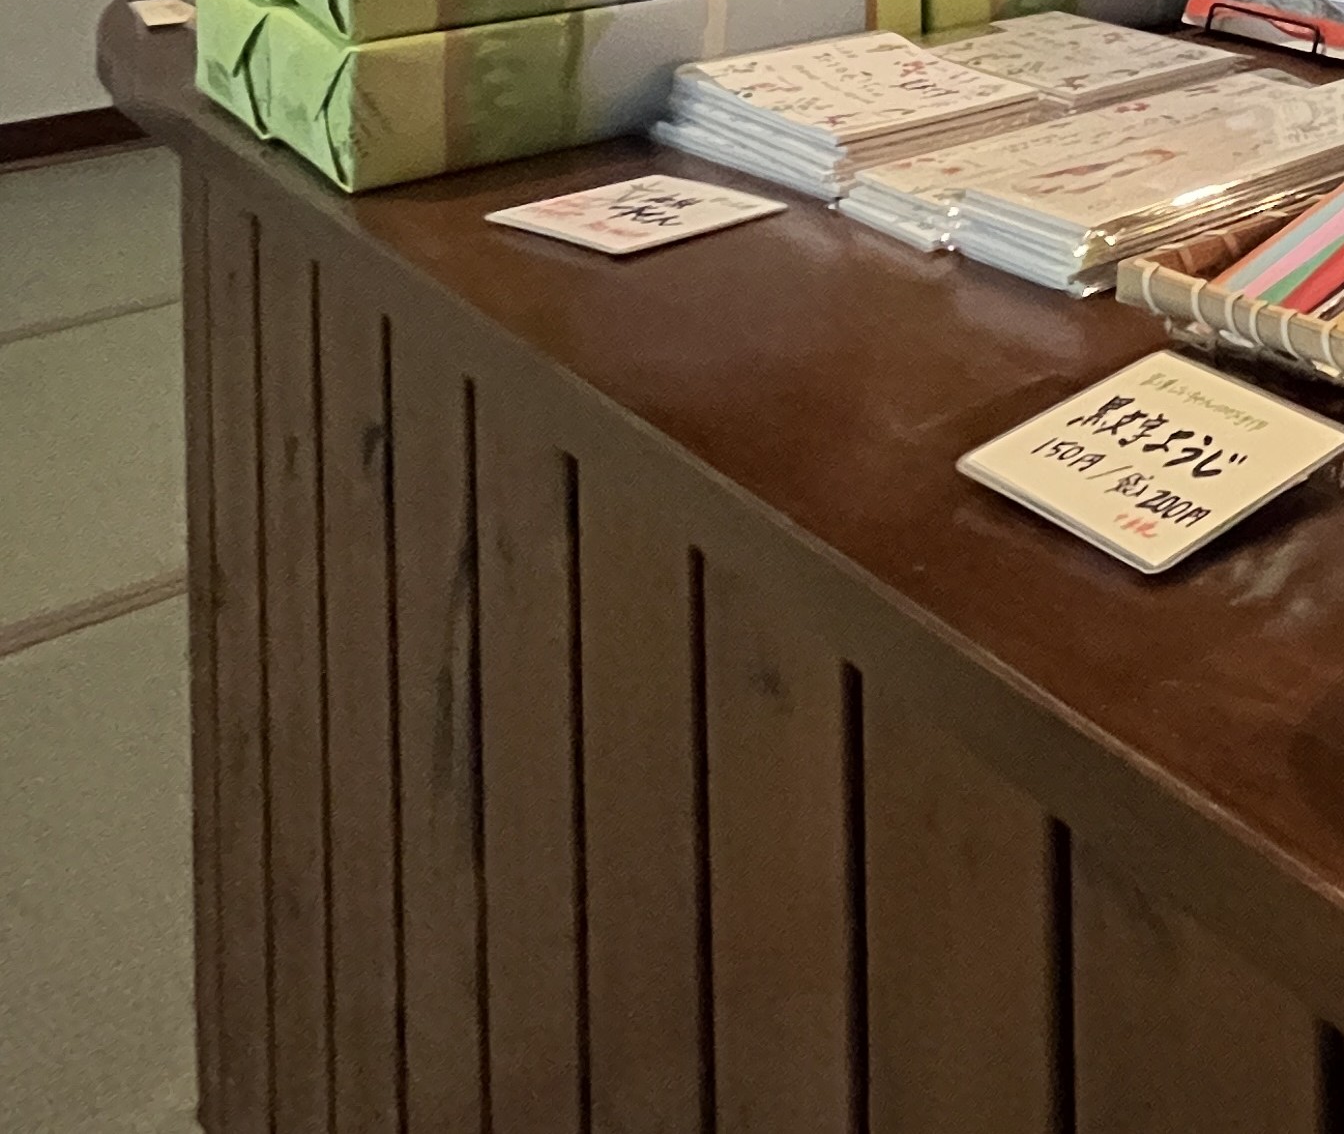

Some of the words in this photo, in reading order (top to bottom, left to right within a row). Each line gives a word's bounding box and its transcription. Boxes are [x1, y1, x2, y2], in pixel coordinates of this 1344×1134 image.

[1066, 395, 1248, 478] 黒文字ようじ
